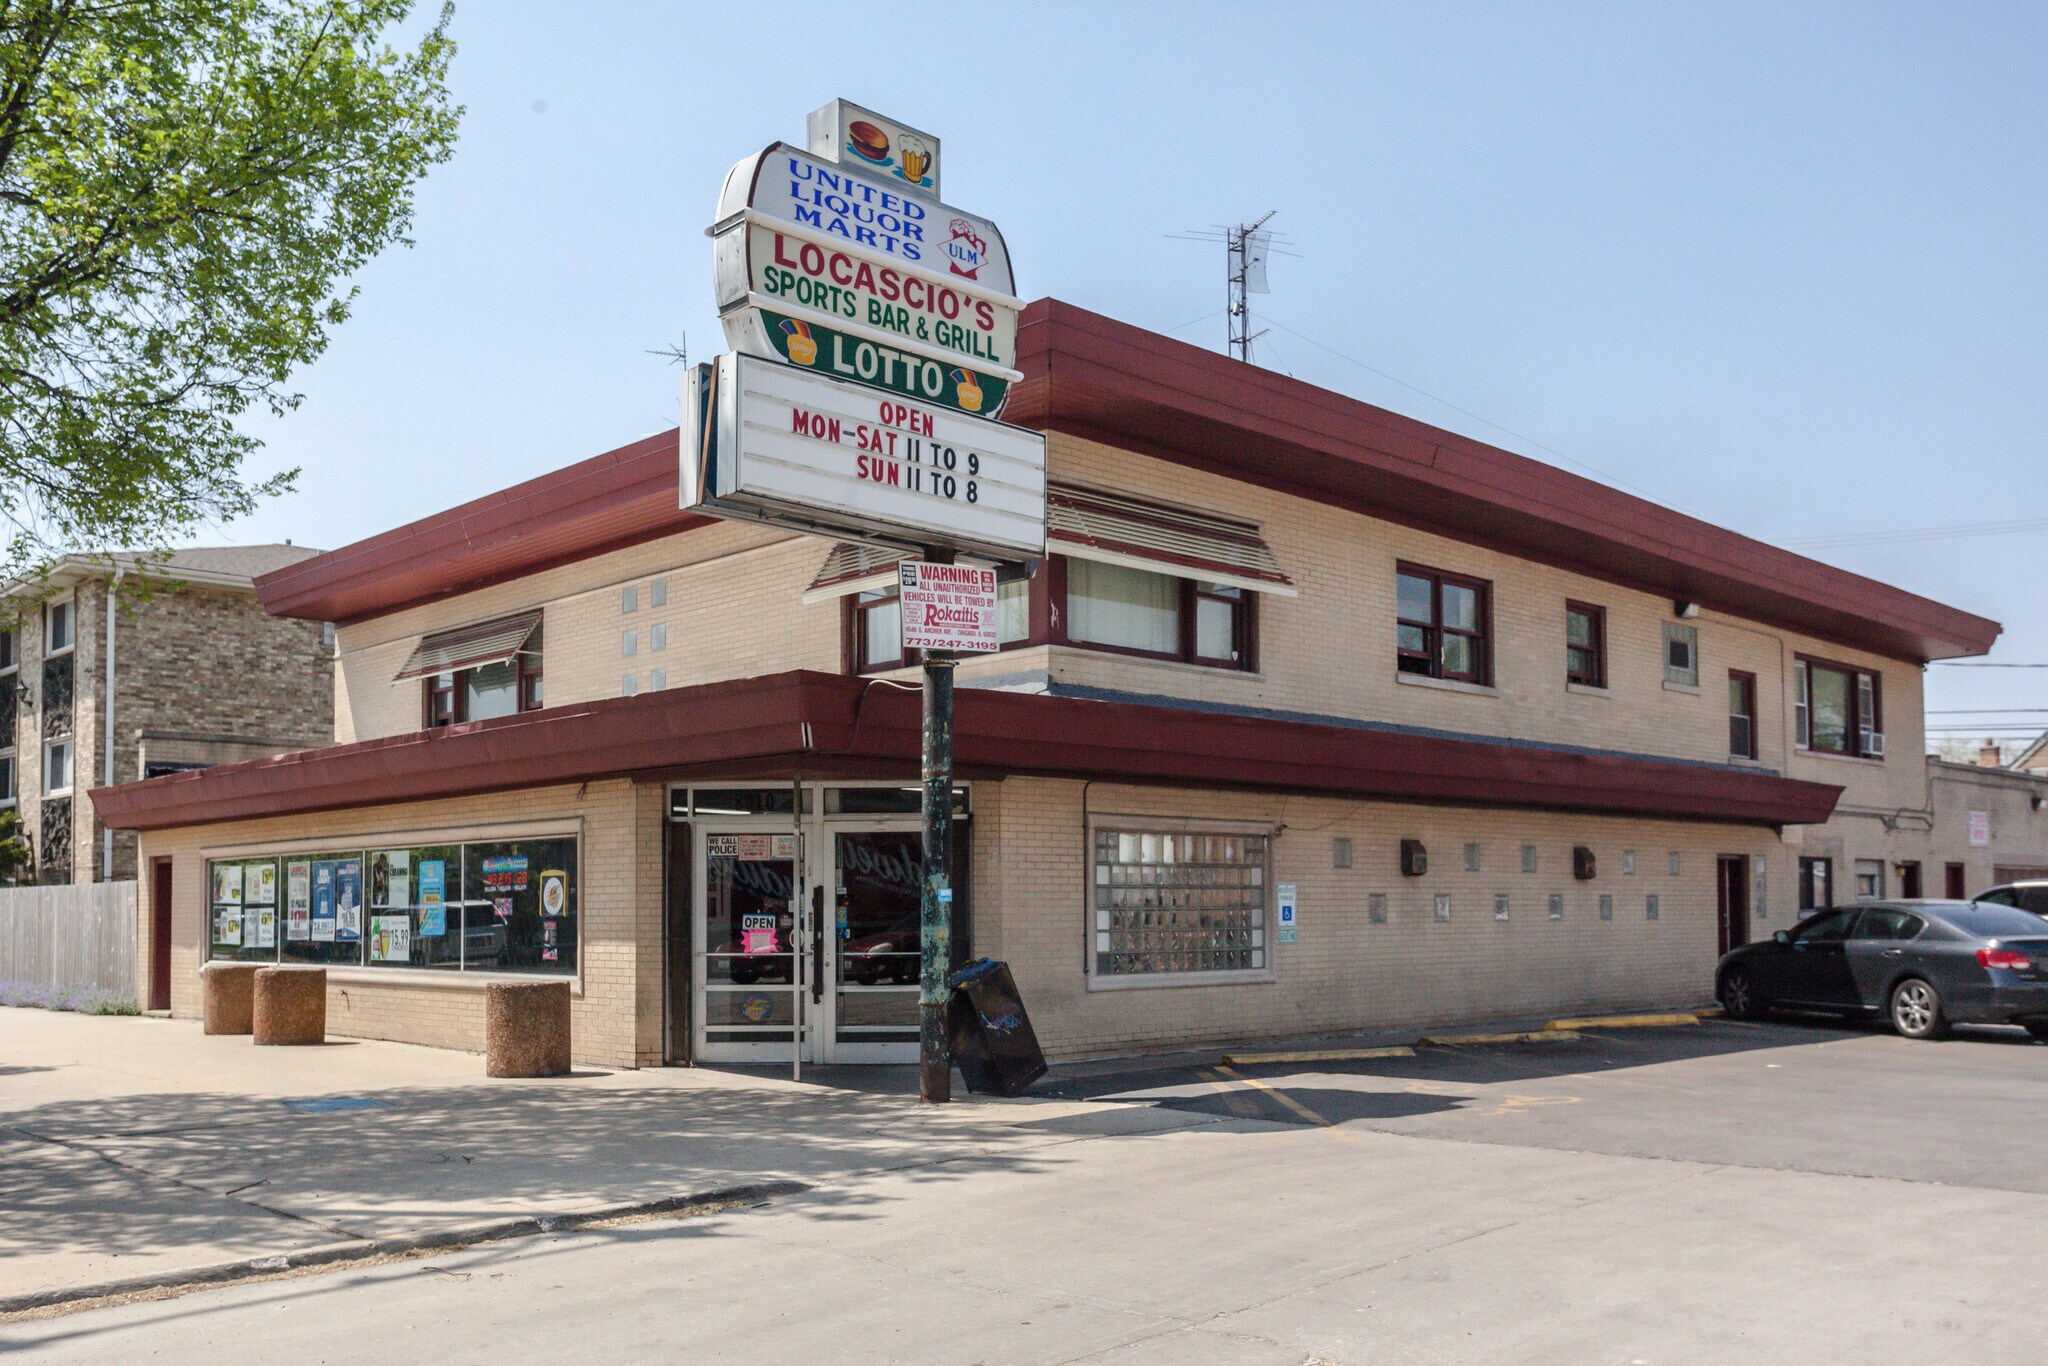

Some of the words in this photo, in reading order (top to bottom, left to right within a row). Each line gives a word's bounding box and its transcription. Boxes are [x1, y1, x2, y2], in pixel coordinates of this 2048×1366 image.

[789, 158, 925, 220] UNITED
[789, 180, 924, 243] LIQUOR
[794, 203, 921, 261] MARTS
[948, 243, 978, 265] ULM
[774, 233, 995, 331] LOCASCIO'S
[763, 265, 857, 318] SPORTS
[868, 298, 910, 335] BAR
[916, 316, 929, 341] &
[935, 320, 1000, 363] GRILL
[833, 335, 943, 397] LOTTO
[880, 401, 933, 438] OPEN
[792, 408, 898, 455] MON-SAT
[930, 443, 957, 470] TO
[968, 453, 979, 475] 9
[857, 455, 899, 486] SUN
[930, 472, 957, 498] TO
[966, 480, 978, 503] 8
[919, 564, 979, 585] WARNING
[919, 581, 931, 591] ALL
[933, 581, 980, 595] UNAUTHORIZED
[904, 591, 936, 602] VEHICLES
[937, 594, 953, 604] WILL
[954, 596, 962, 605] BE
[964, 596, 985, 607] TOWED
[986, 598, 994, 608] BY
[924, 604, 979, 627] Rokaitis
[906, 637, 997, 650] 773/247-3195
[709, 837, 719, 845] WE
[721, 837, 737, 845] CALL
[709, 845, 737, 855] POLICE
[744, 917, 774, 929] OPEN
